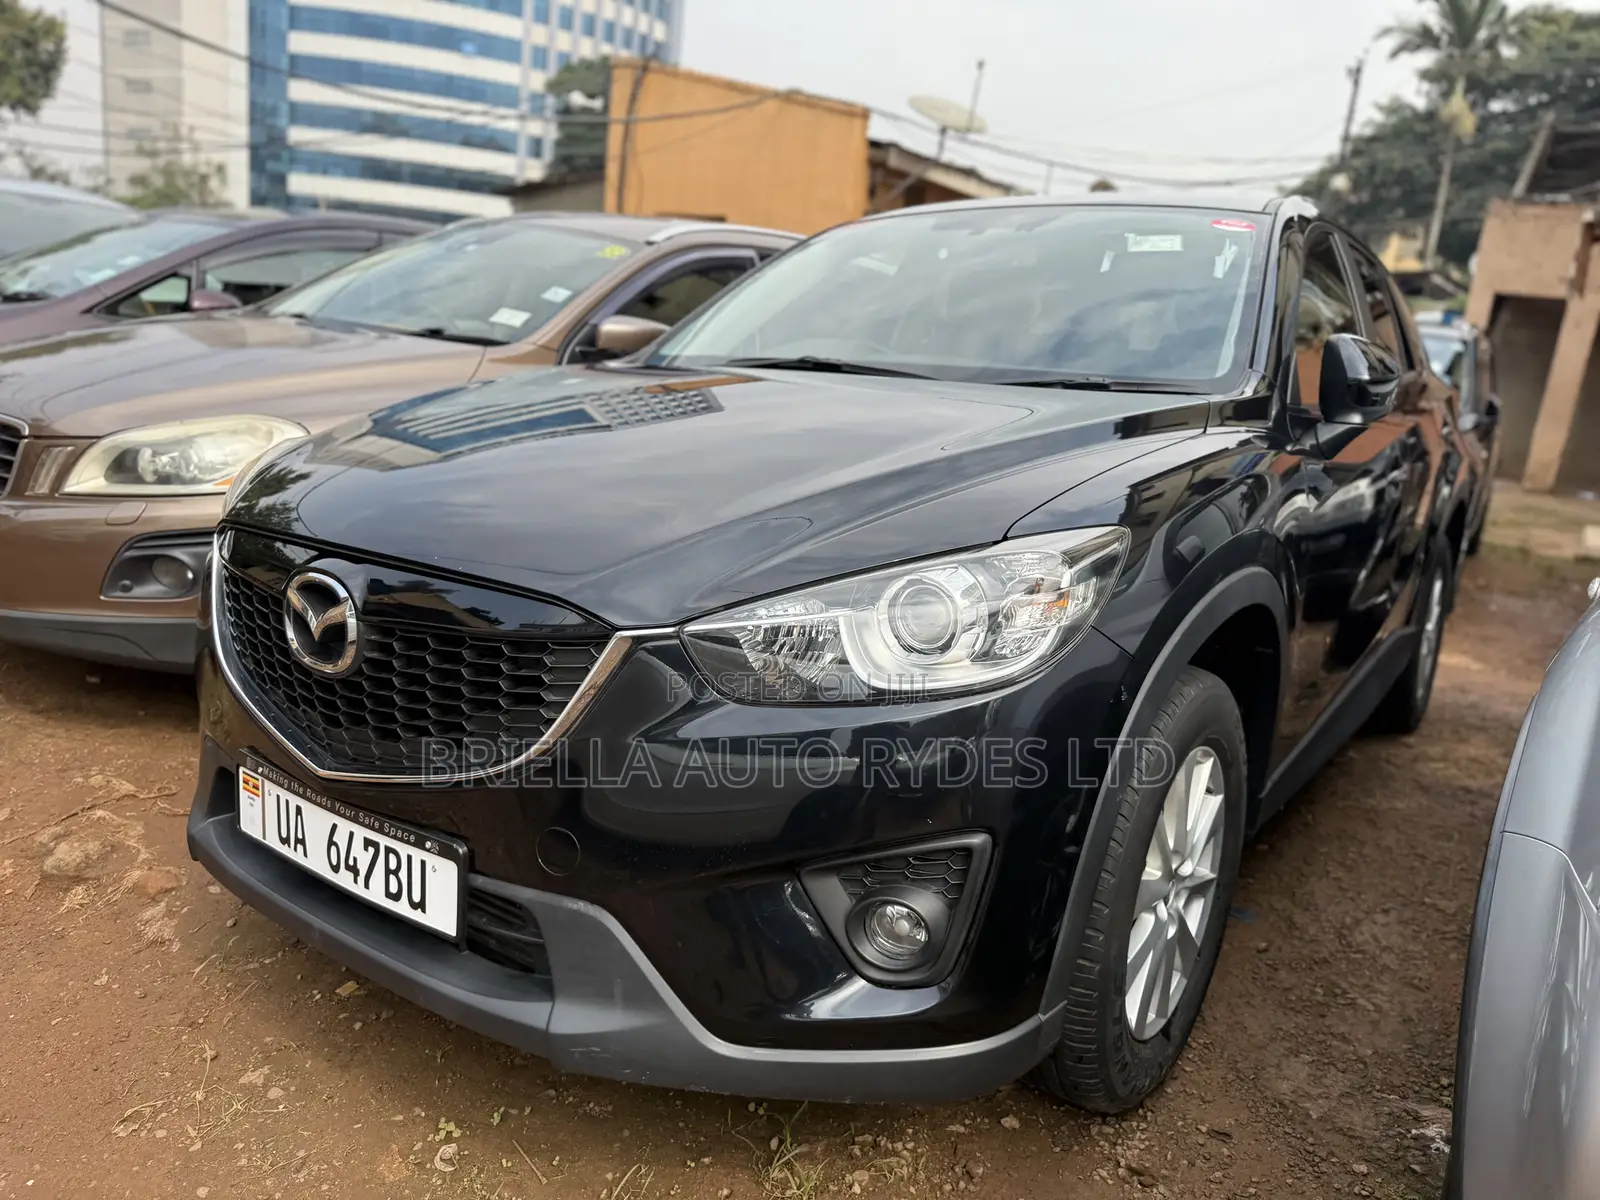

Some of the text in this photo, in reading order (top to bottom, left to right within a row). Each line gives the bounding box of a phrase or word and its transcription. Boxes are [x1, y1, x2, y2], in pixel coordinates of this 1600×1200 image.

[263, 766, 416, 844] Making the Roads Your Safe Space
[277, 793, 427, 914] UA 647BU
